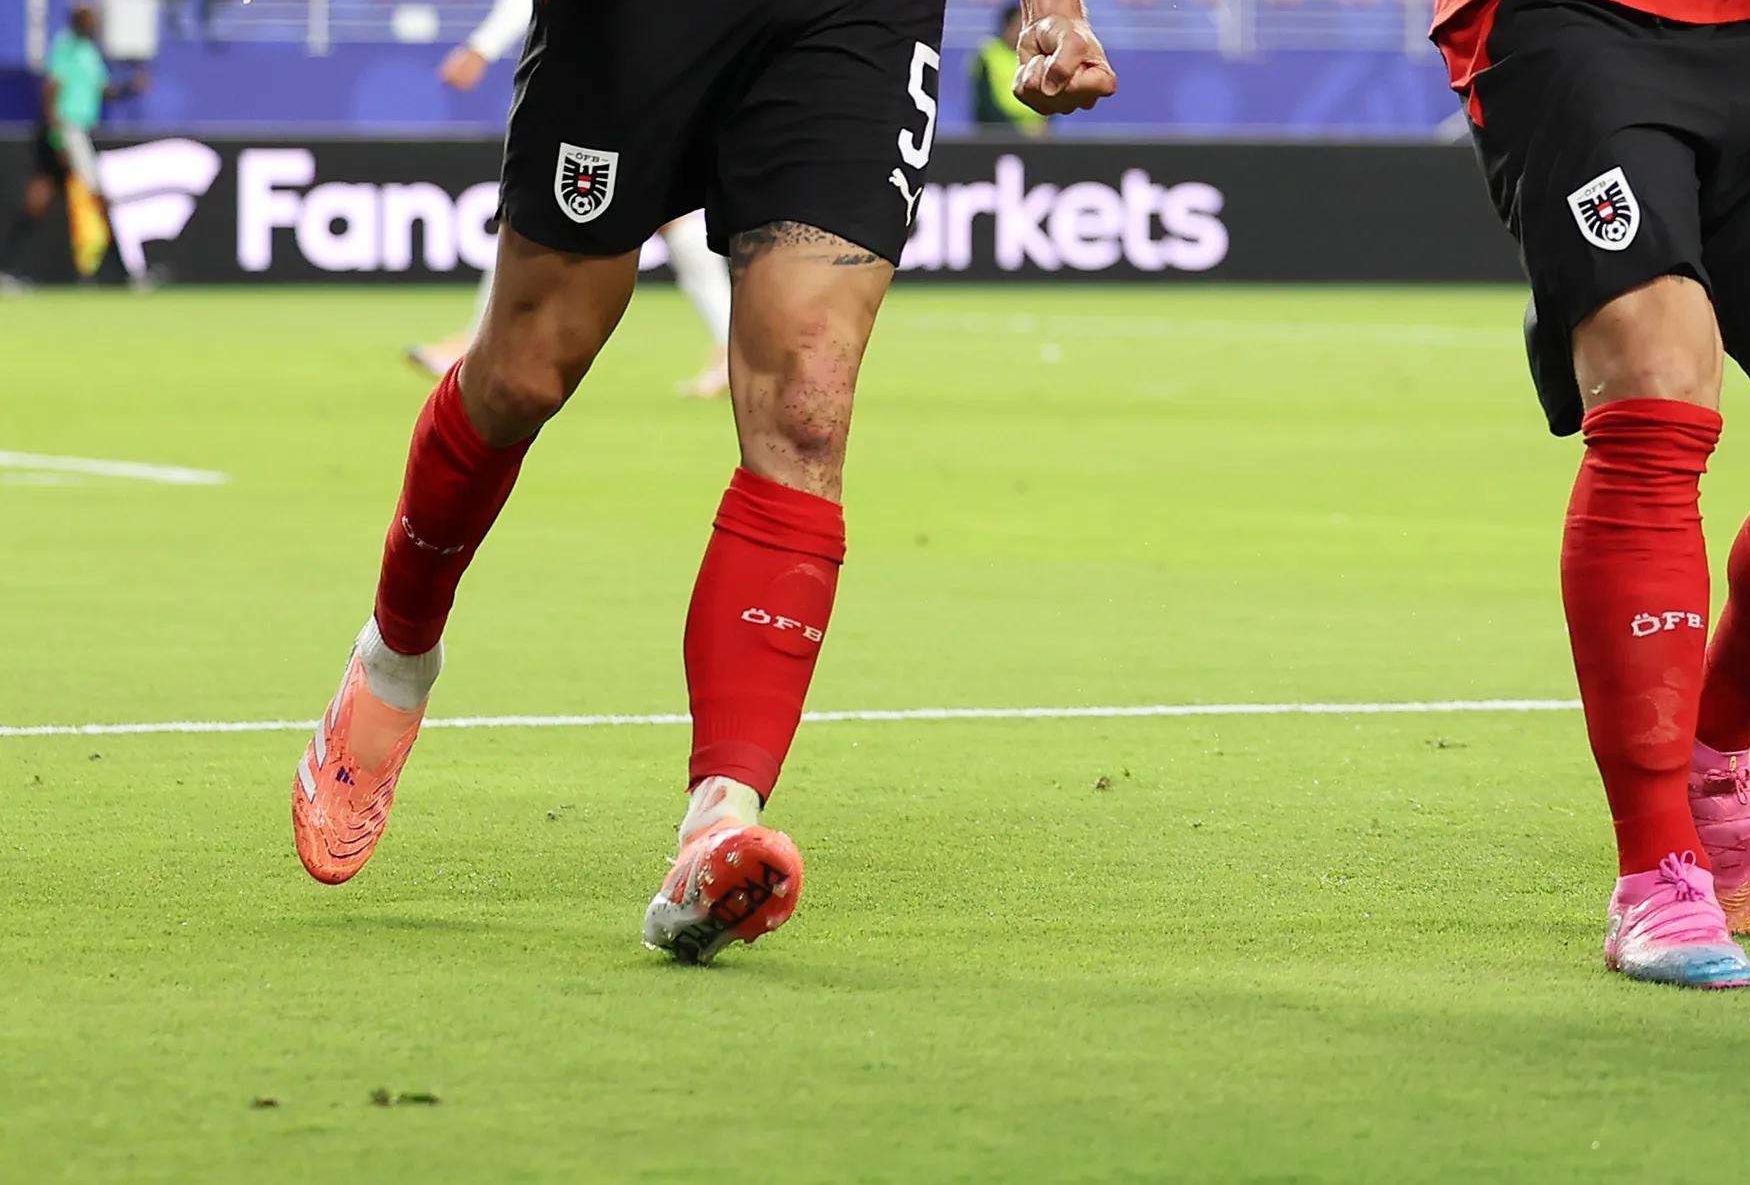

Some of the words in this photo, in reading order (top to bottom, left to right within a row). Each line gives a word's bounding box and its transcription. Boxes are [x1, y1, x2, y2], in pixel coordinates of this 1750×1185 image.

[898, 41, 941, 169] 5
[741, 607, 822, 643] ÖFB
[1631, 611, 1704, 638] ÖFB
